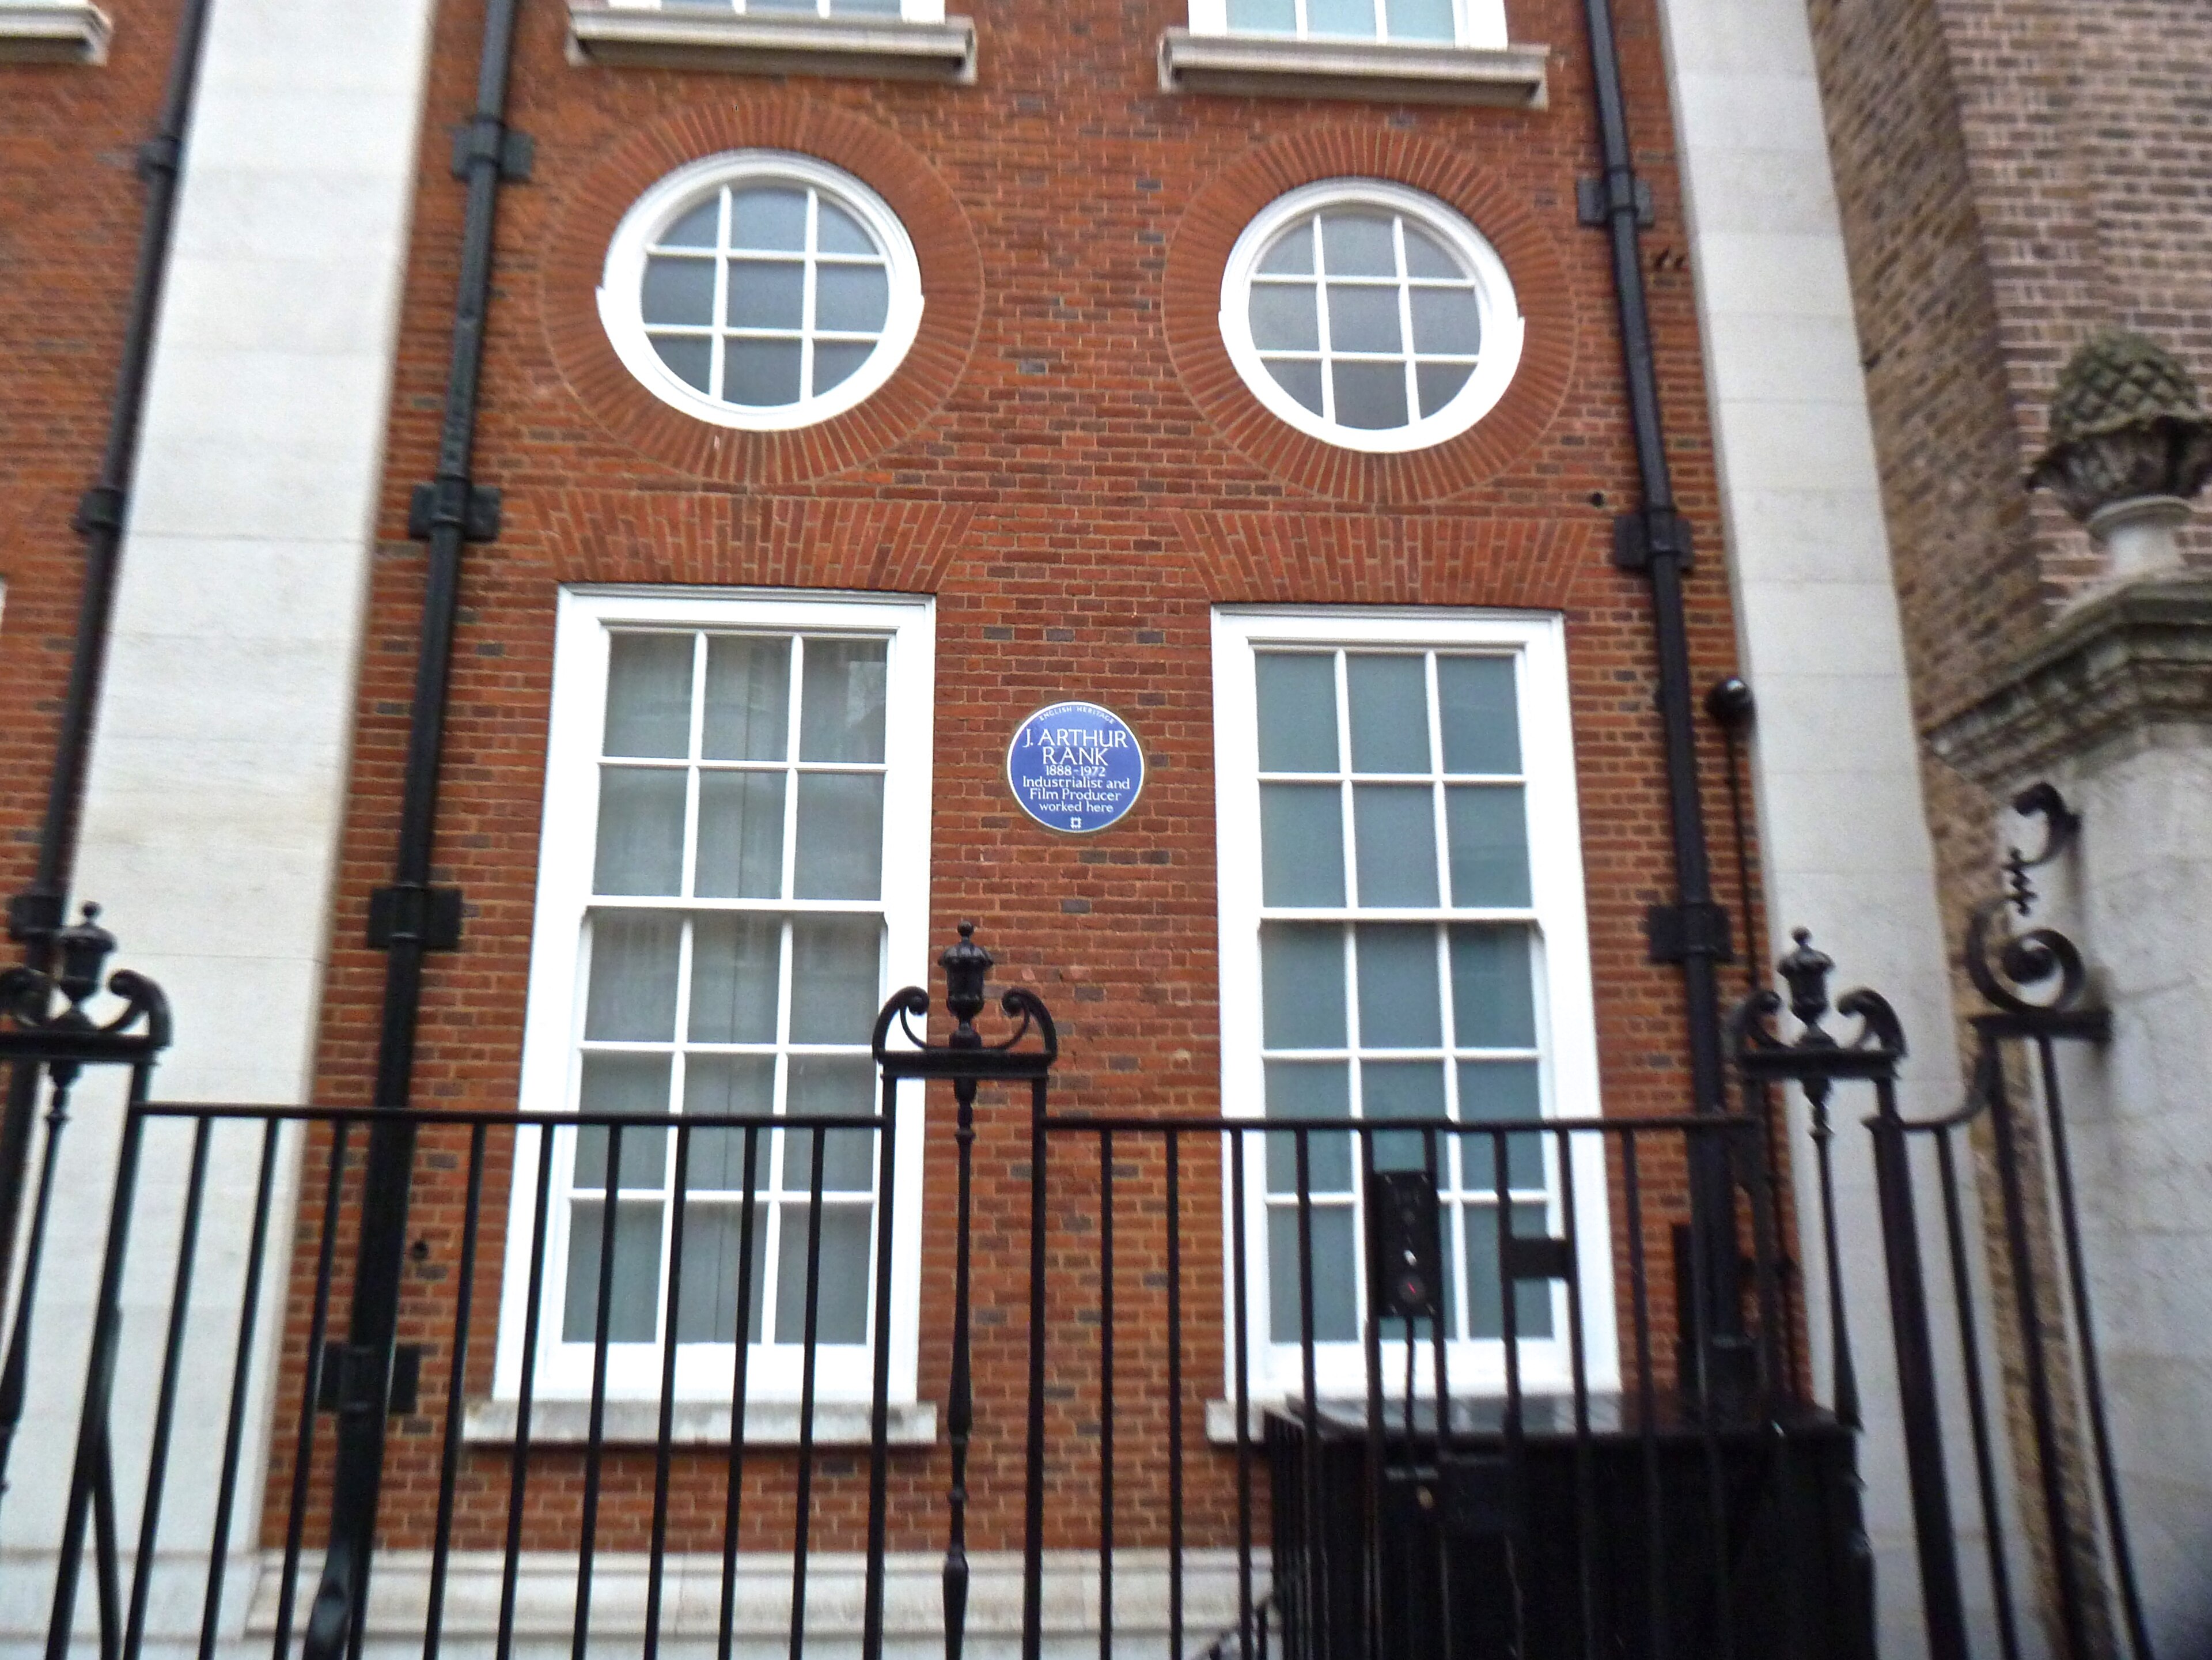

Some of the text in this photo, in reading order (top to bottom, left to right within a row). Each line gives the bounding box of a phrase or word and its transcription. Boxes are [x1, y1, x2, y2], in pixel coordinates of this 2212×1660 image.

[1039, 706, 1115, 724] ENGLISH HERITAGE
[1022, 728, 1128, 748] J. ARTHUR
[1043, 746, 1109, 766] RANK
[1022, 776, 1130, 789] Industrialist and
[1029, 788, 1122, 801] Film Producer
[1039, 801, 1114, 812] worked here
